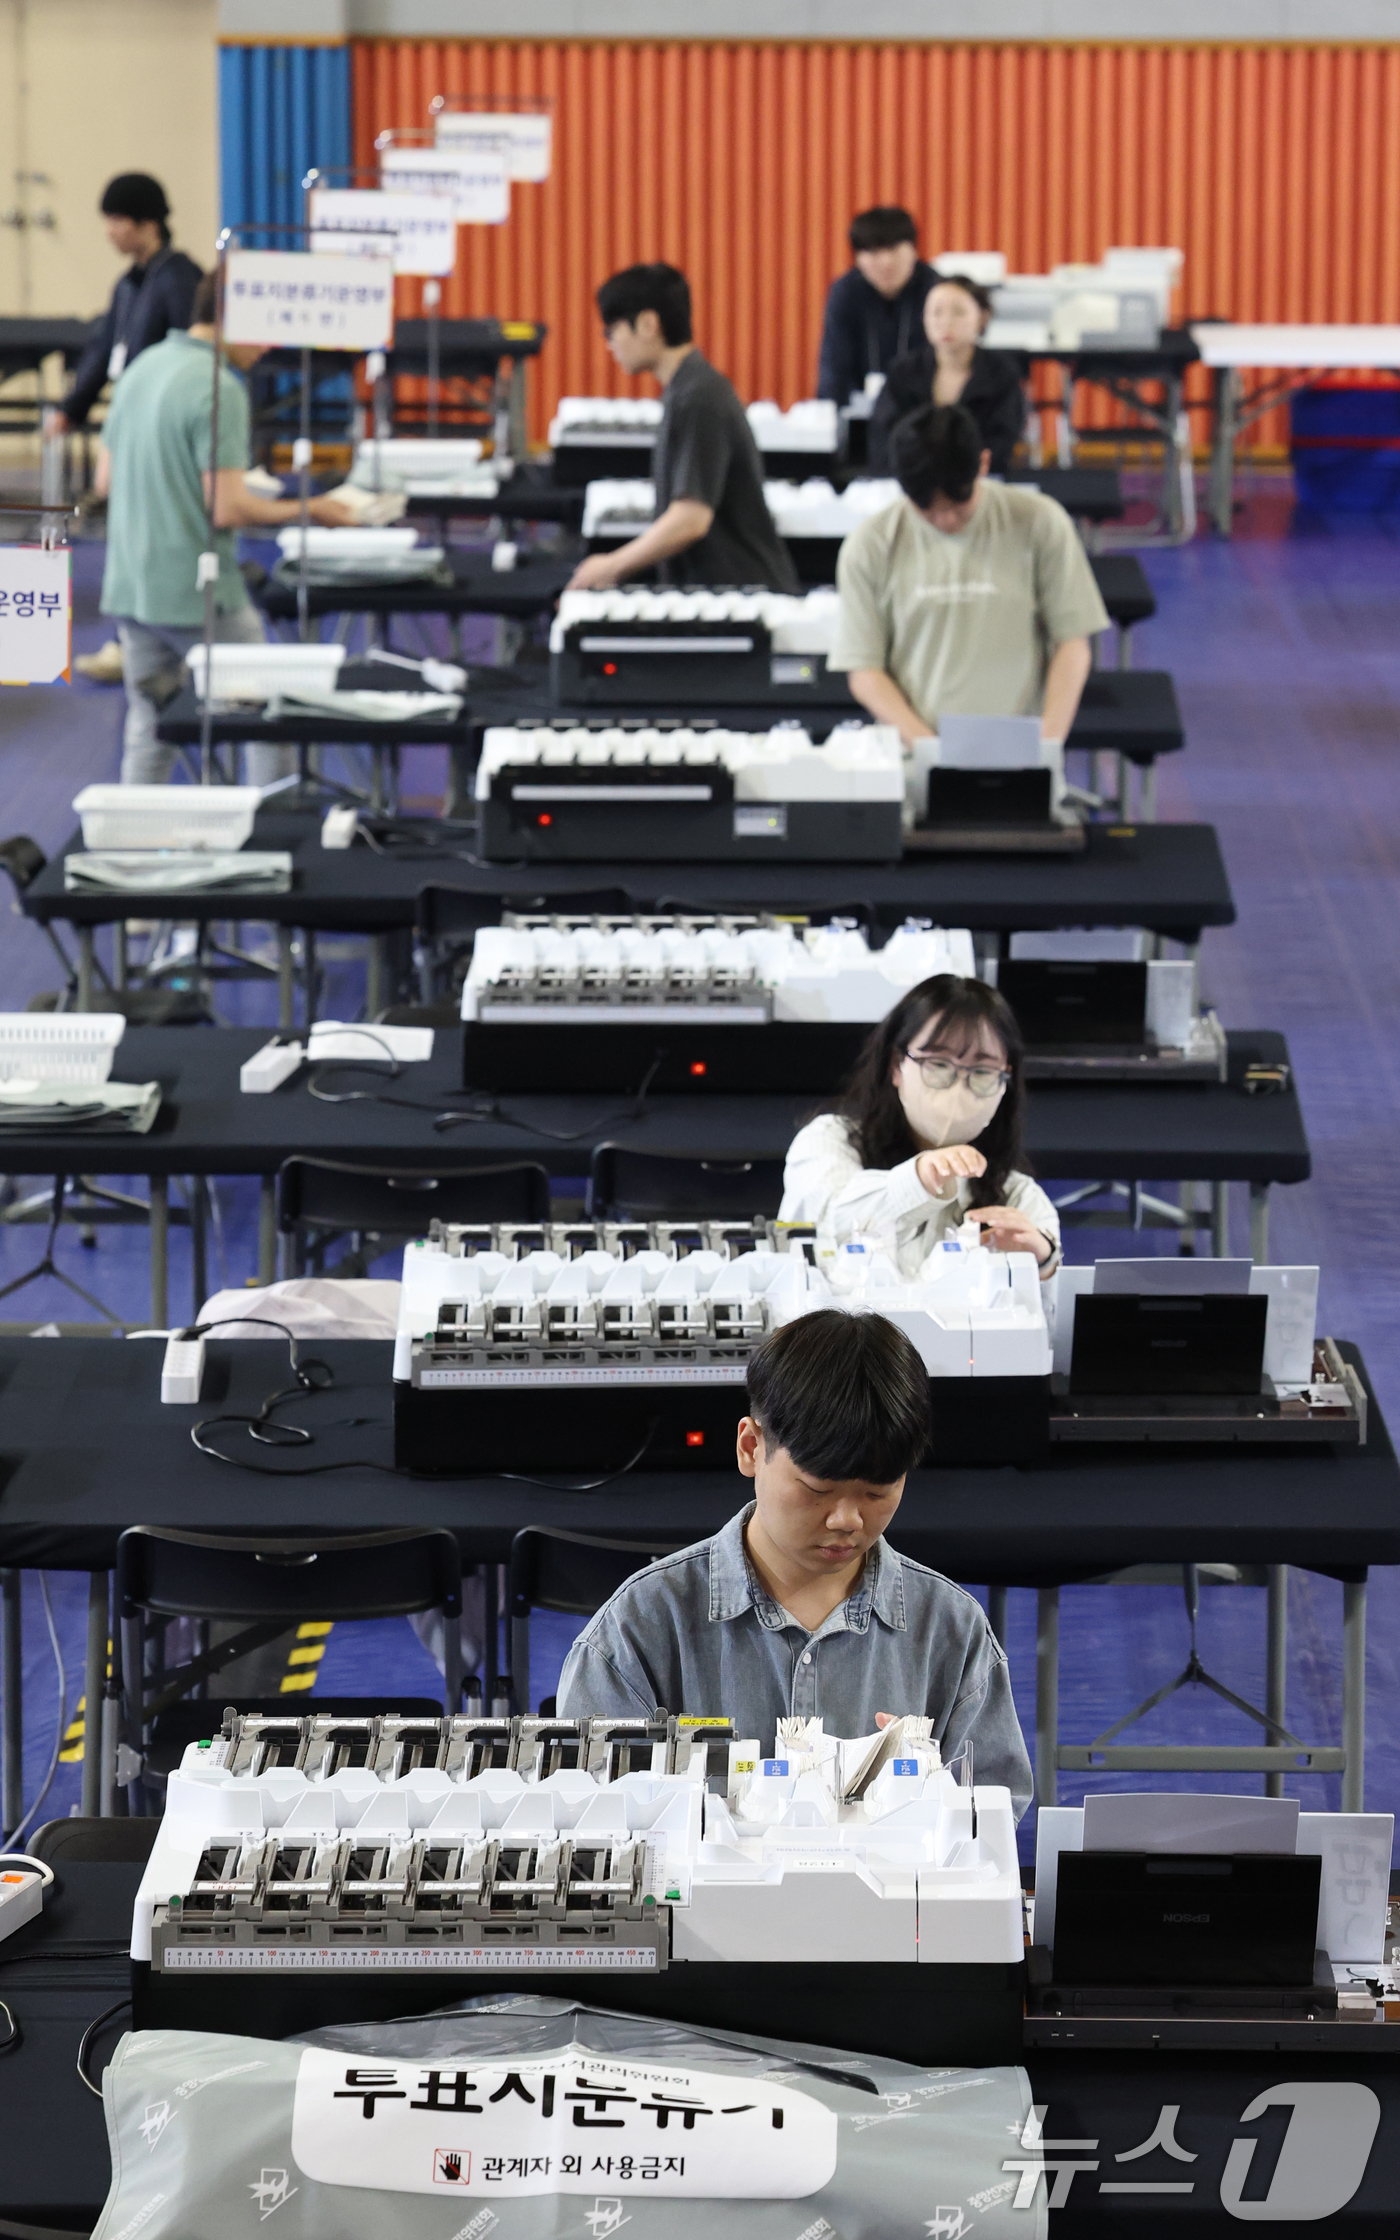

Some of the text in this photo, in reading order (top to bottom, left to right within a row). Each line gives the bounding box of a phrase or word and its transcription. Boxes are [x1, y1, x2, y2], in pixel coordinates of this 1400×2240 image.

[1163, 1914, 1210, 1922] EPSON
[482, 2155, 686, 2181] 관계자 외 사용금지
